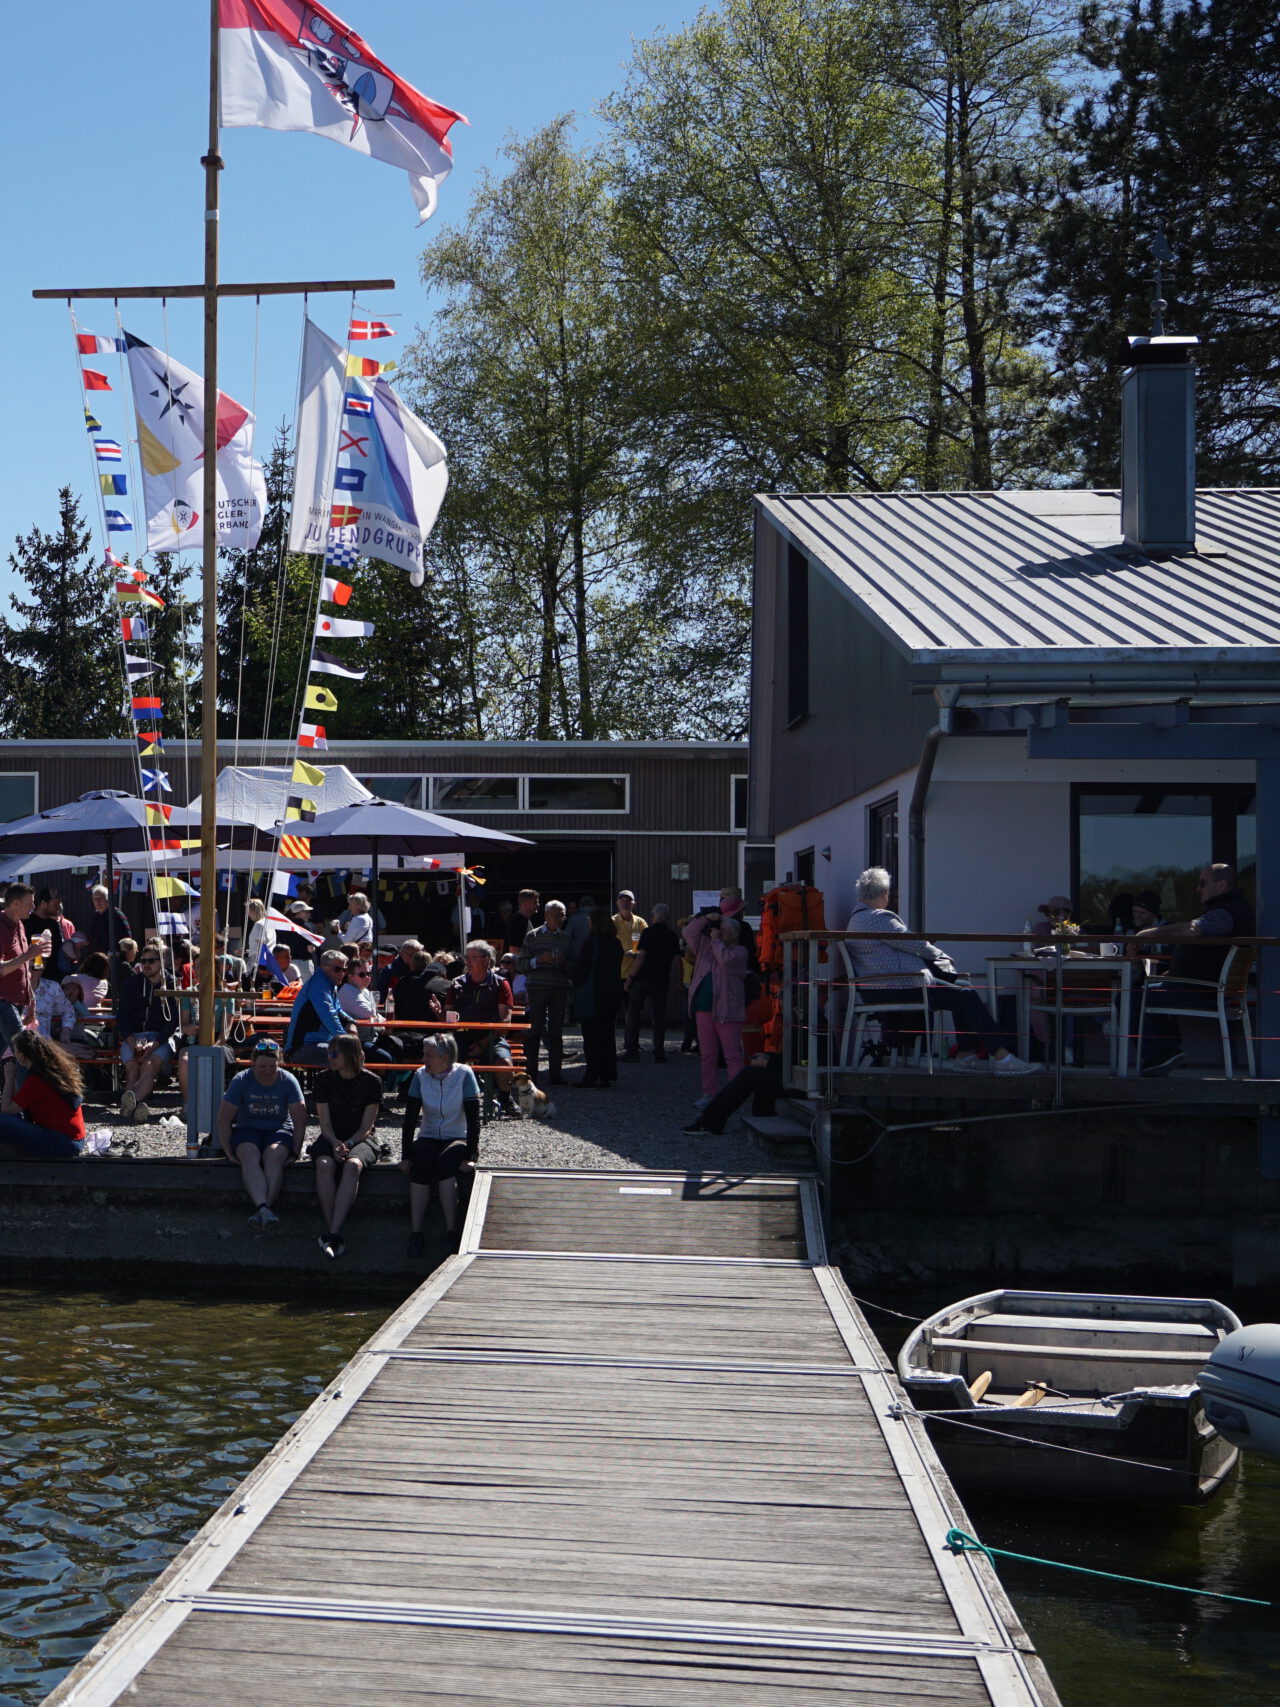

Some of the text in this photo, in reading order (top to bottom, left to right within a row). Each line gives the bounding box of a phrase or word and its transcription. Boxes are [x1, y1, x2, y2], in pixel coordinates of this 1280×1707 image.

[217, 498, 257, 509] UTSCHER
[217, 510, 247, 519] GLER-
[304, 522, 421, 562] JUGENDGRUPP
